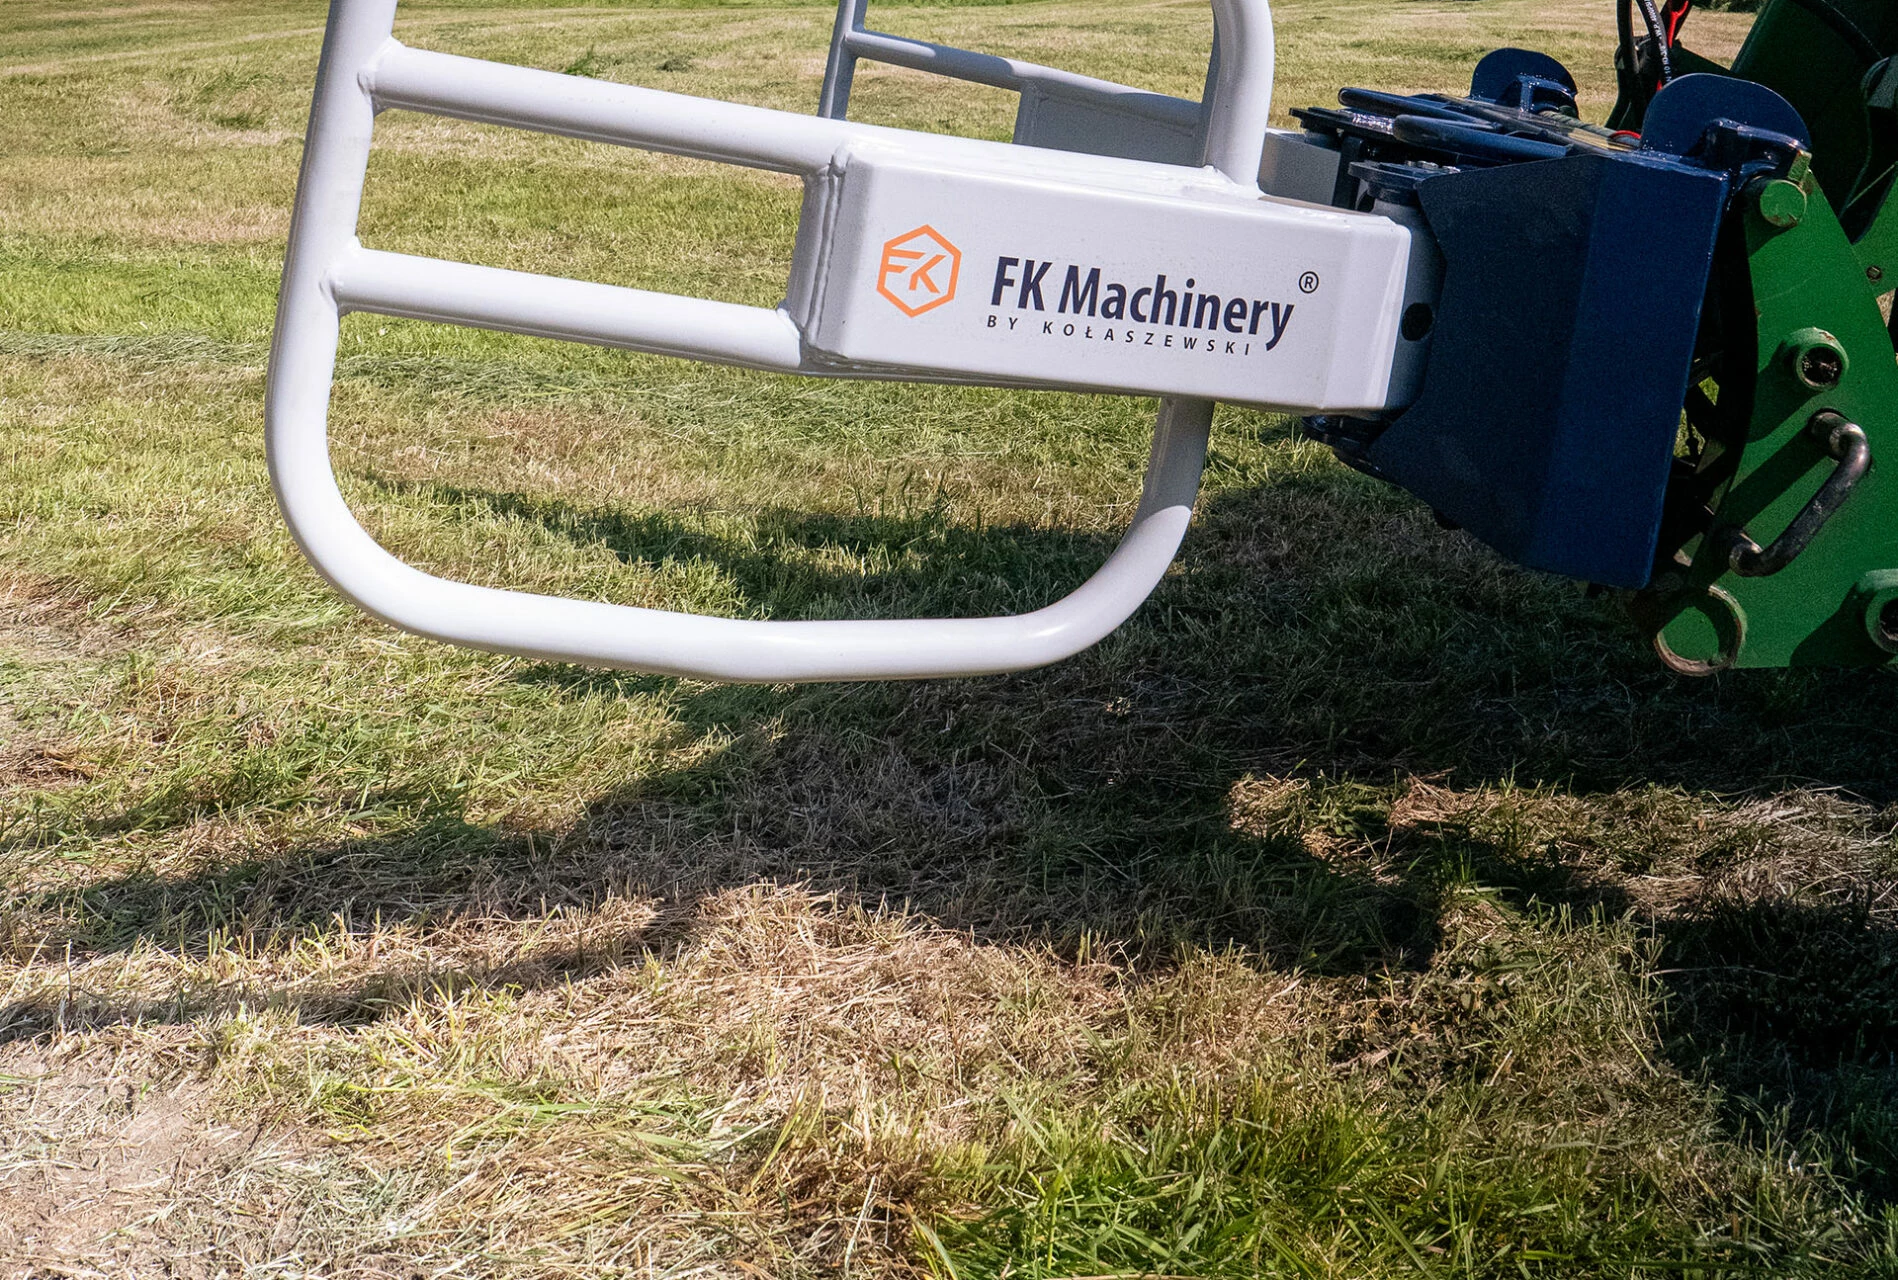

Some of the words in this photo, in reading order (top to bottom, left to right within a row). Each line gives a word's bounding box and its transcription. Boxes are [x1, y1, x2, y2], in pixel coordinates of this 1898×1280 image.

[986, 314, 1018, 330] BY
[1042, 321, 1251, 357] KOŁASZEWSKI
[990, 256, 1053, 312] FK
[1057, 264, 1295, 352] Machinery
